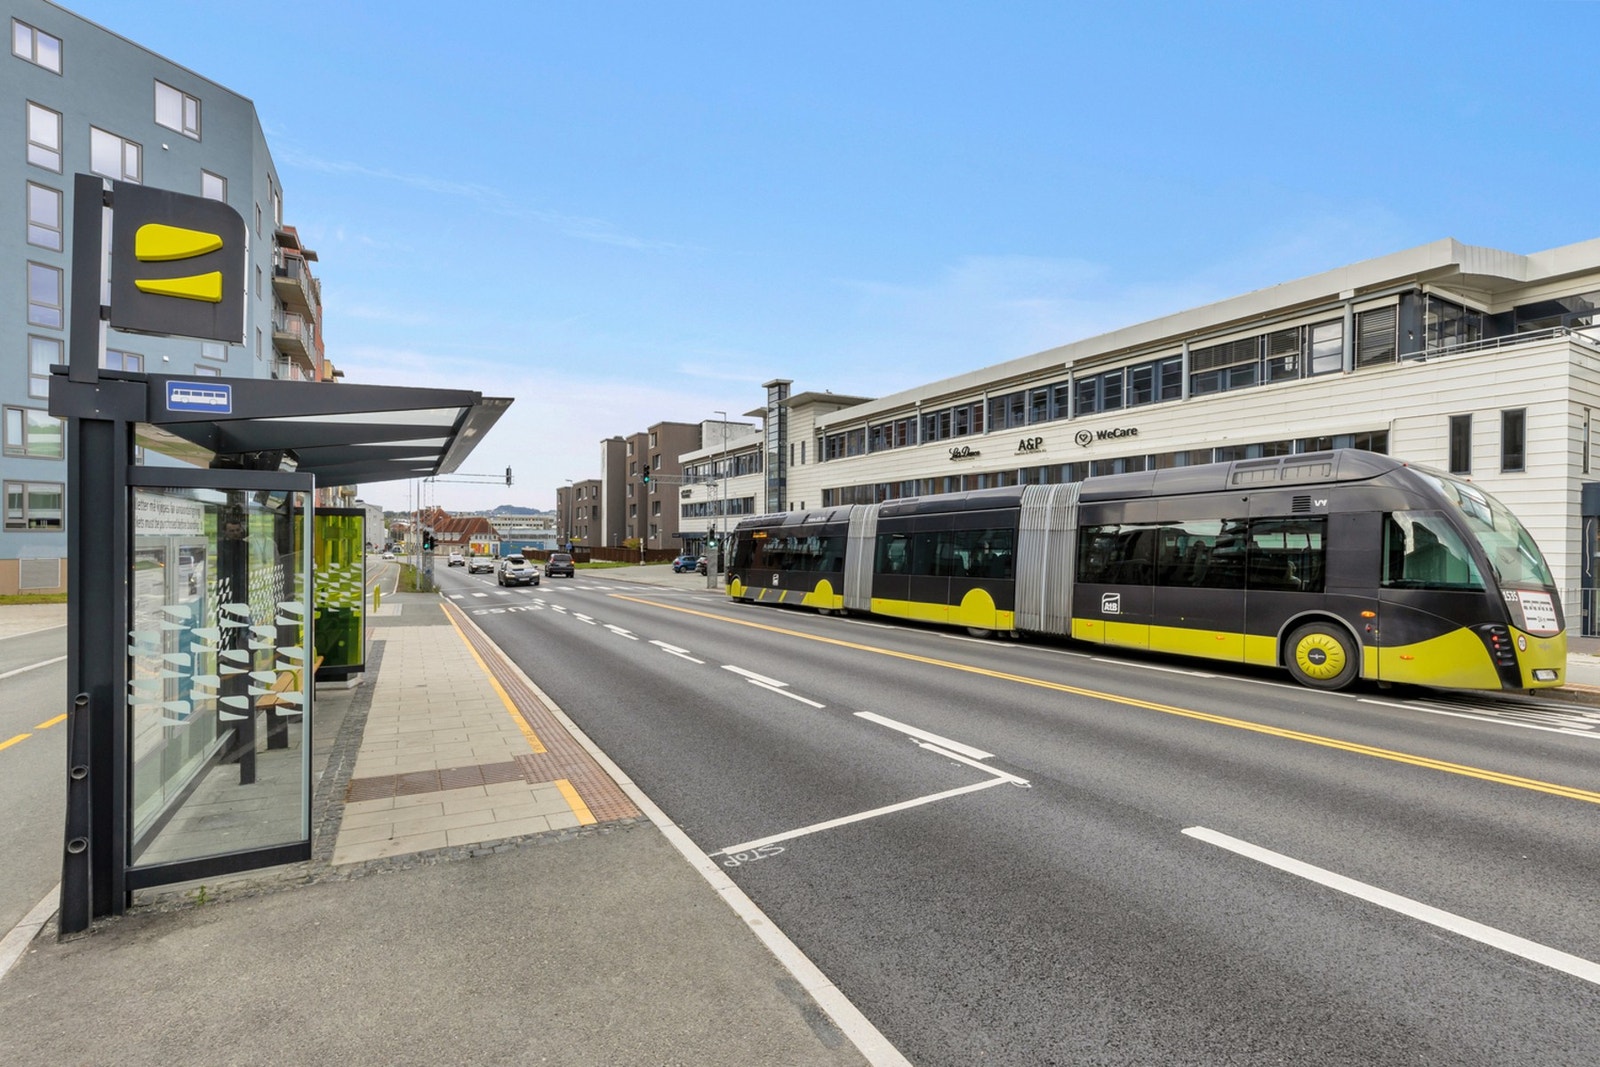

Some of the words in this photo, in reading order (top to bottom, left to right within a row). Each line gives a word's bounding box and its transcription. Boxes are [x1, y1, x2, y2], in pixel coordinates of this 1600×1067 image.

[1096, 427, 1138, 440] WeCare
[1017, 437, 1043, 451] A&P
[1502, 590, 1518, 602] 1535
[1104, 602, 1118, 611] AtB
